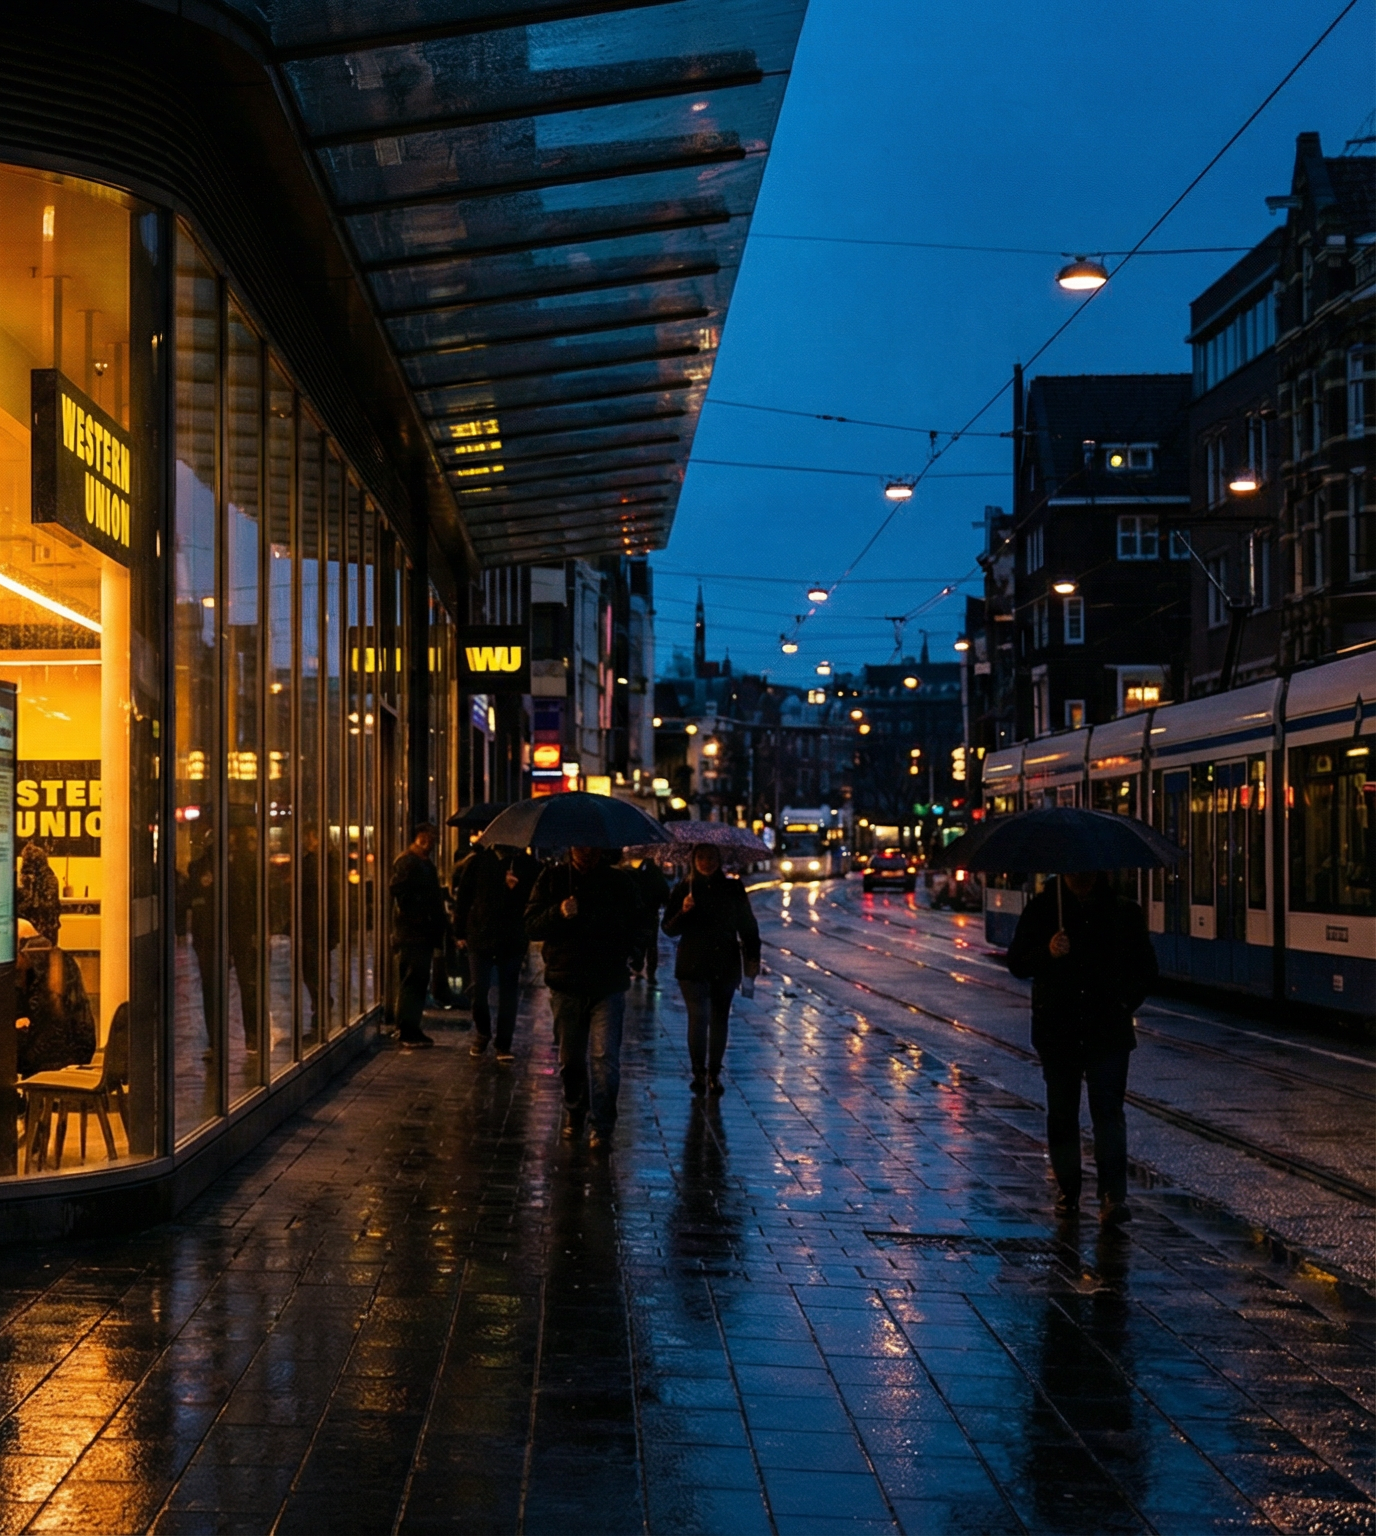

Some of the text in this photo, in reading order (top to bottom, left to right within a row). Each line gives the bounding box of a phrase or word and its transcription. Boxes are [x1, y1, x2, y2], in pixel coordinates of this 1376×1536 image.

[61, 392, 130, 494] WESTERN
[85, 471, 130, 548] UNION
[466, 646, 522, 672] WU
